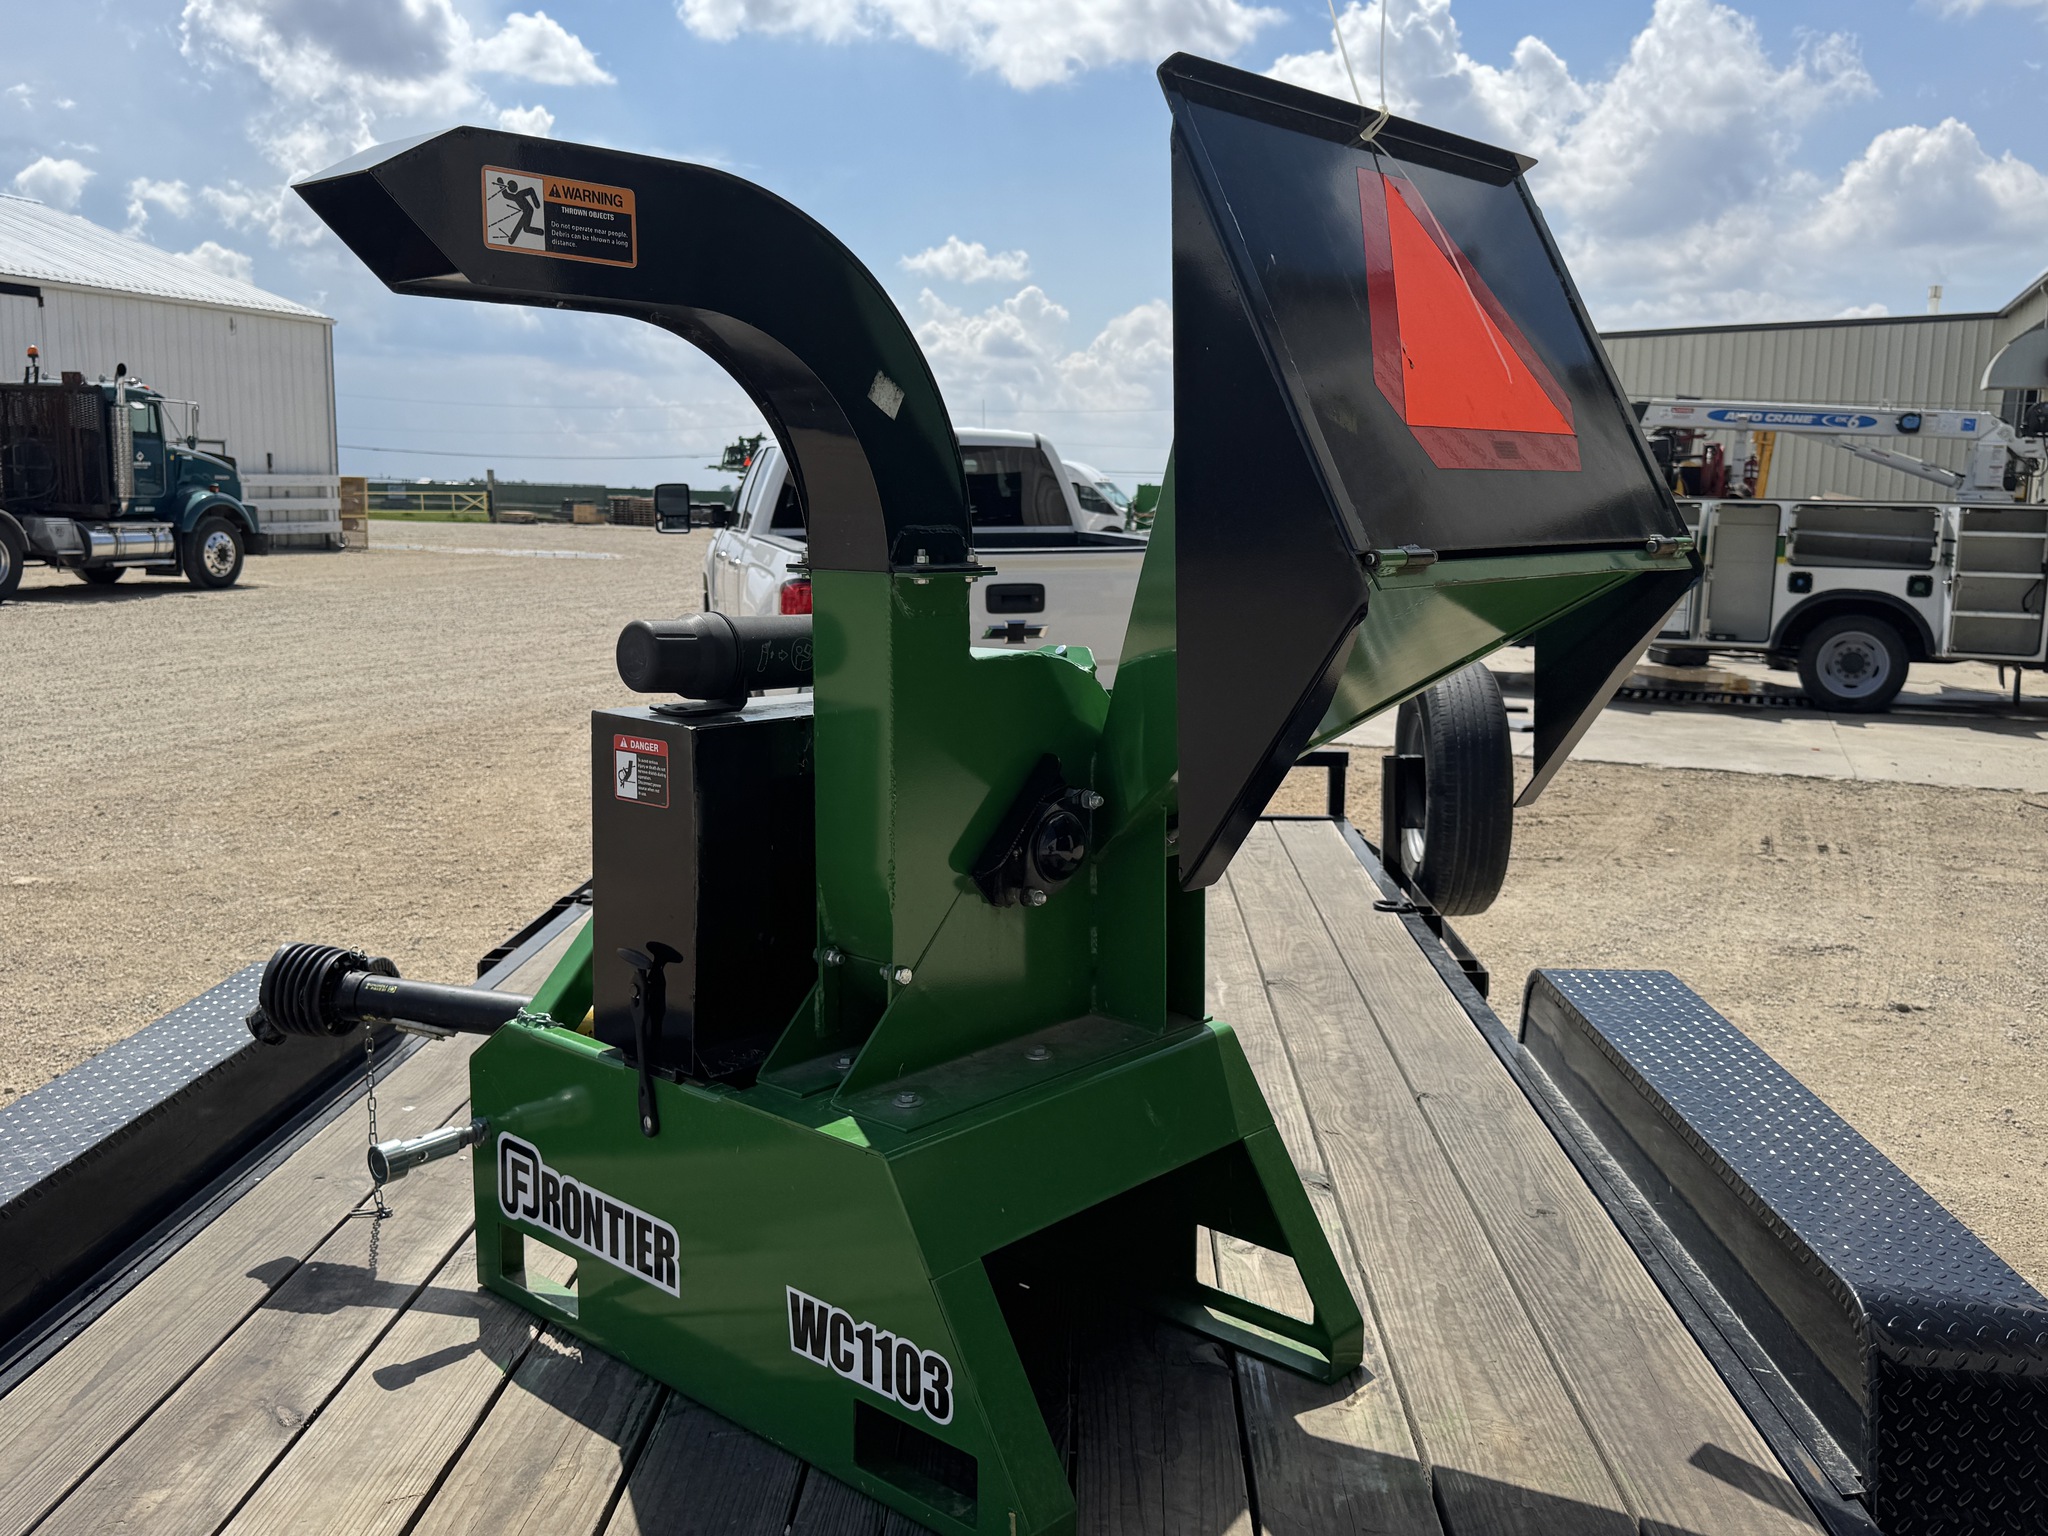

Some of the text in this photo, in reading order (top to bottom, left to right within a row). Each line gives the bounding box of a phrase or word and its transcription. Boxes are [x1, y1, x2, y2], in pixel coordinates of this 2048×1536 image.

[562, 185, 623, 208] WARNING
[561, 206, 615, 221] THROWN OBJECTS
[572, 225, 593, 233] operate
[551, 229, 570, 238] Debris
[591, 236, 610, 244] thrown
[616, 239, 628, 248] long
[1765, 413, 1814, 424] CRANE
[630, 740, 659, 753] DANGER
[500, 1138, 676, 1289] FRONTIER
[789, 1291, 950, 1420] WC1103
